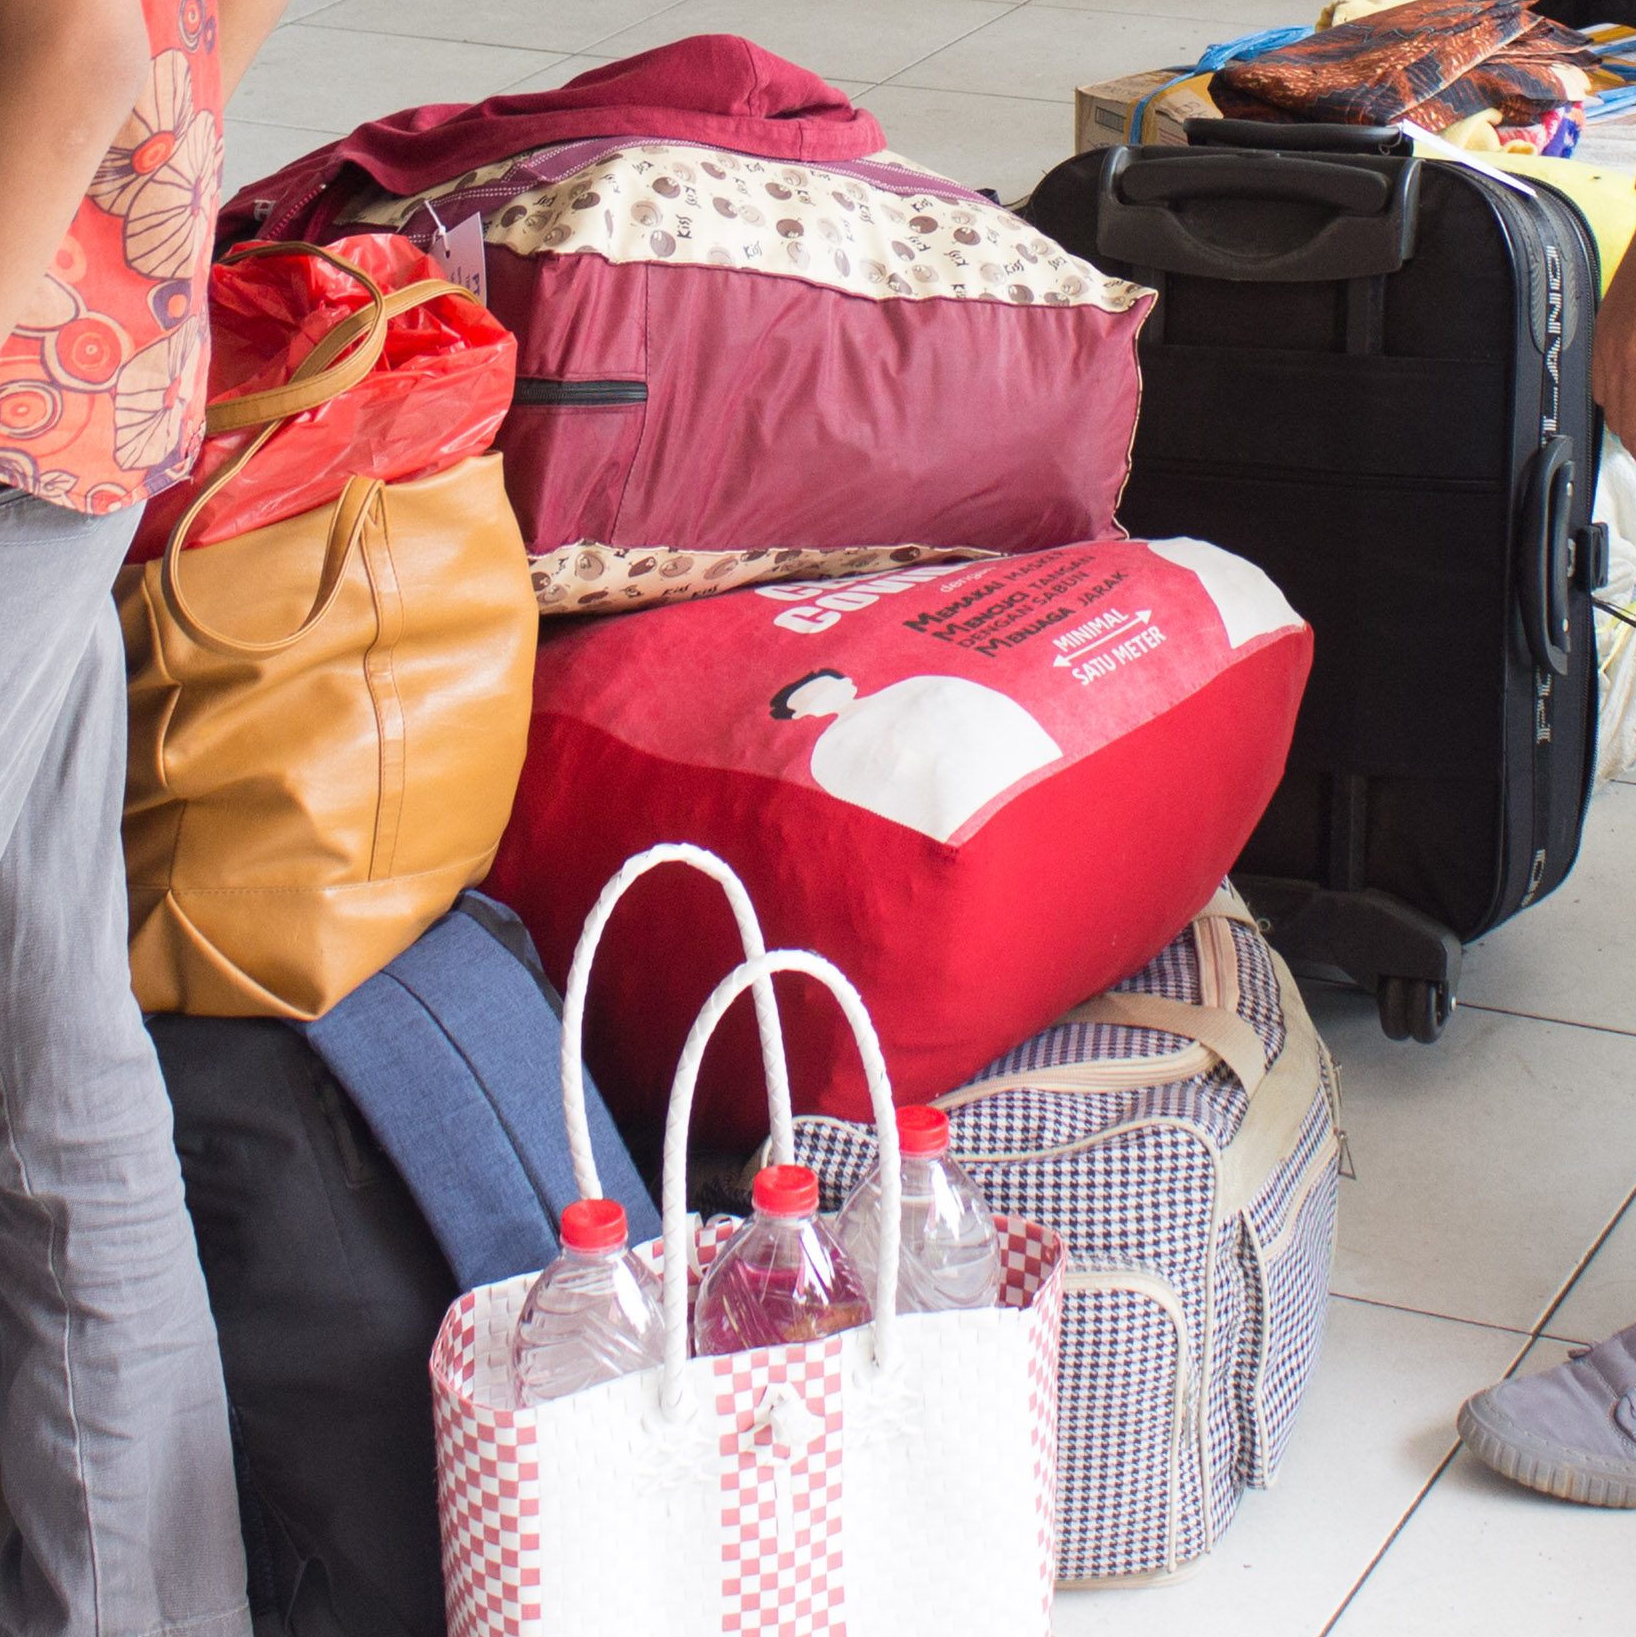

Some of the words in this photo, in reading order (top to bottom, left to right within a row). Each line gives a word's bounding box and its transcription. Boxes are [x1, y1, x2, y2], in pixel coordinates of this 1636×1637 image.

[1027, 554, 1097, 592] TANGAN
[1075, 570, 1130, 608] JARAK
[955, 606, 1036, 648] DENGAN
[1031, 571, 1091, 610] SABUN
[1052, 607, 1130, 653] MINIMAL
[1071, 651, 1118, 687] SATU
[1114, 625, 1168, 668] METER
